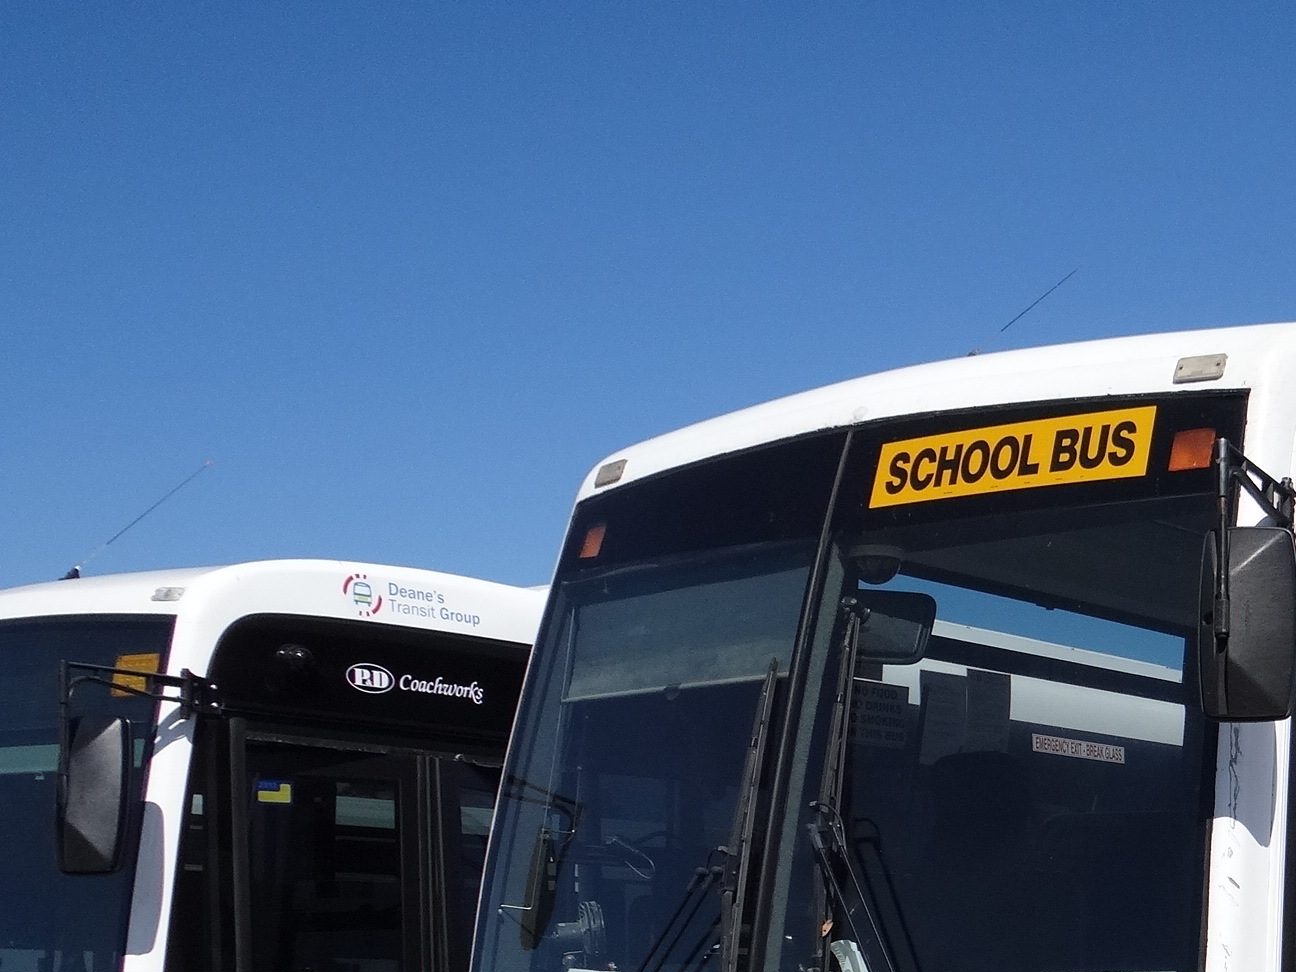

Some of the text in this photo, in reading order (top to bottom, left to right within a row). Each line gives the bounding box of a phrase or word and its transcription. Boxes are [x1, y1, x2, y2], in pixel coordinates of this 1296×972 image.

[885, 420, 1137, 495] SCHOOL BUS
[388, 582, 445, 604] Deane's
[388, 599, 481, 627] Transit Group
[399, 674, 484, 705] Coachworks
[1035, 736, 1069, 754] EMERGENCY
[1070, 741, 1082, 755] EXIT
[1086, 744, 1104, 758] BREAK
[1104, 747, 1123, 761] GLASS
